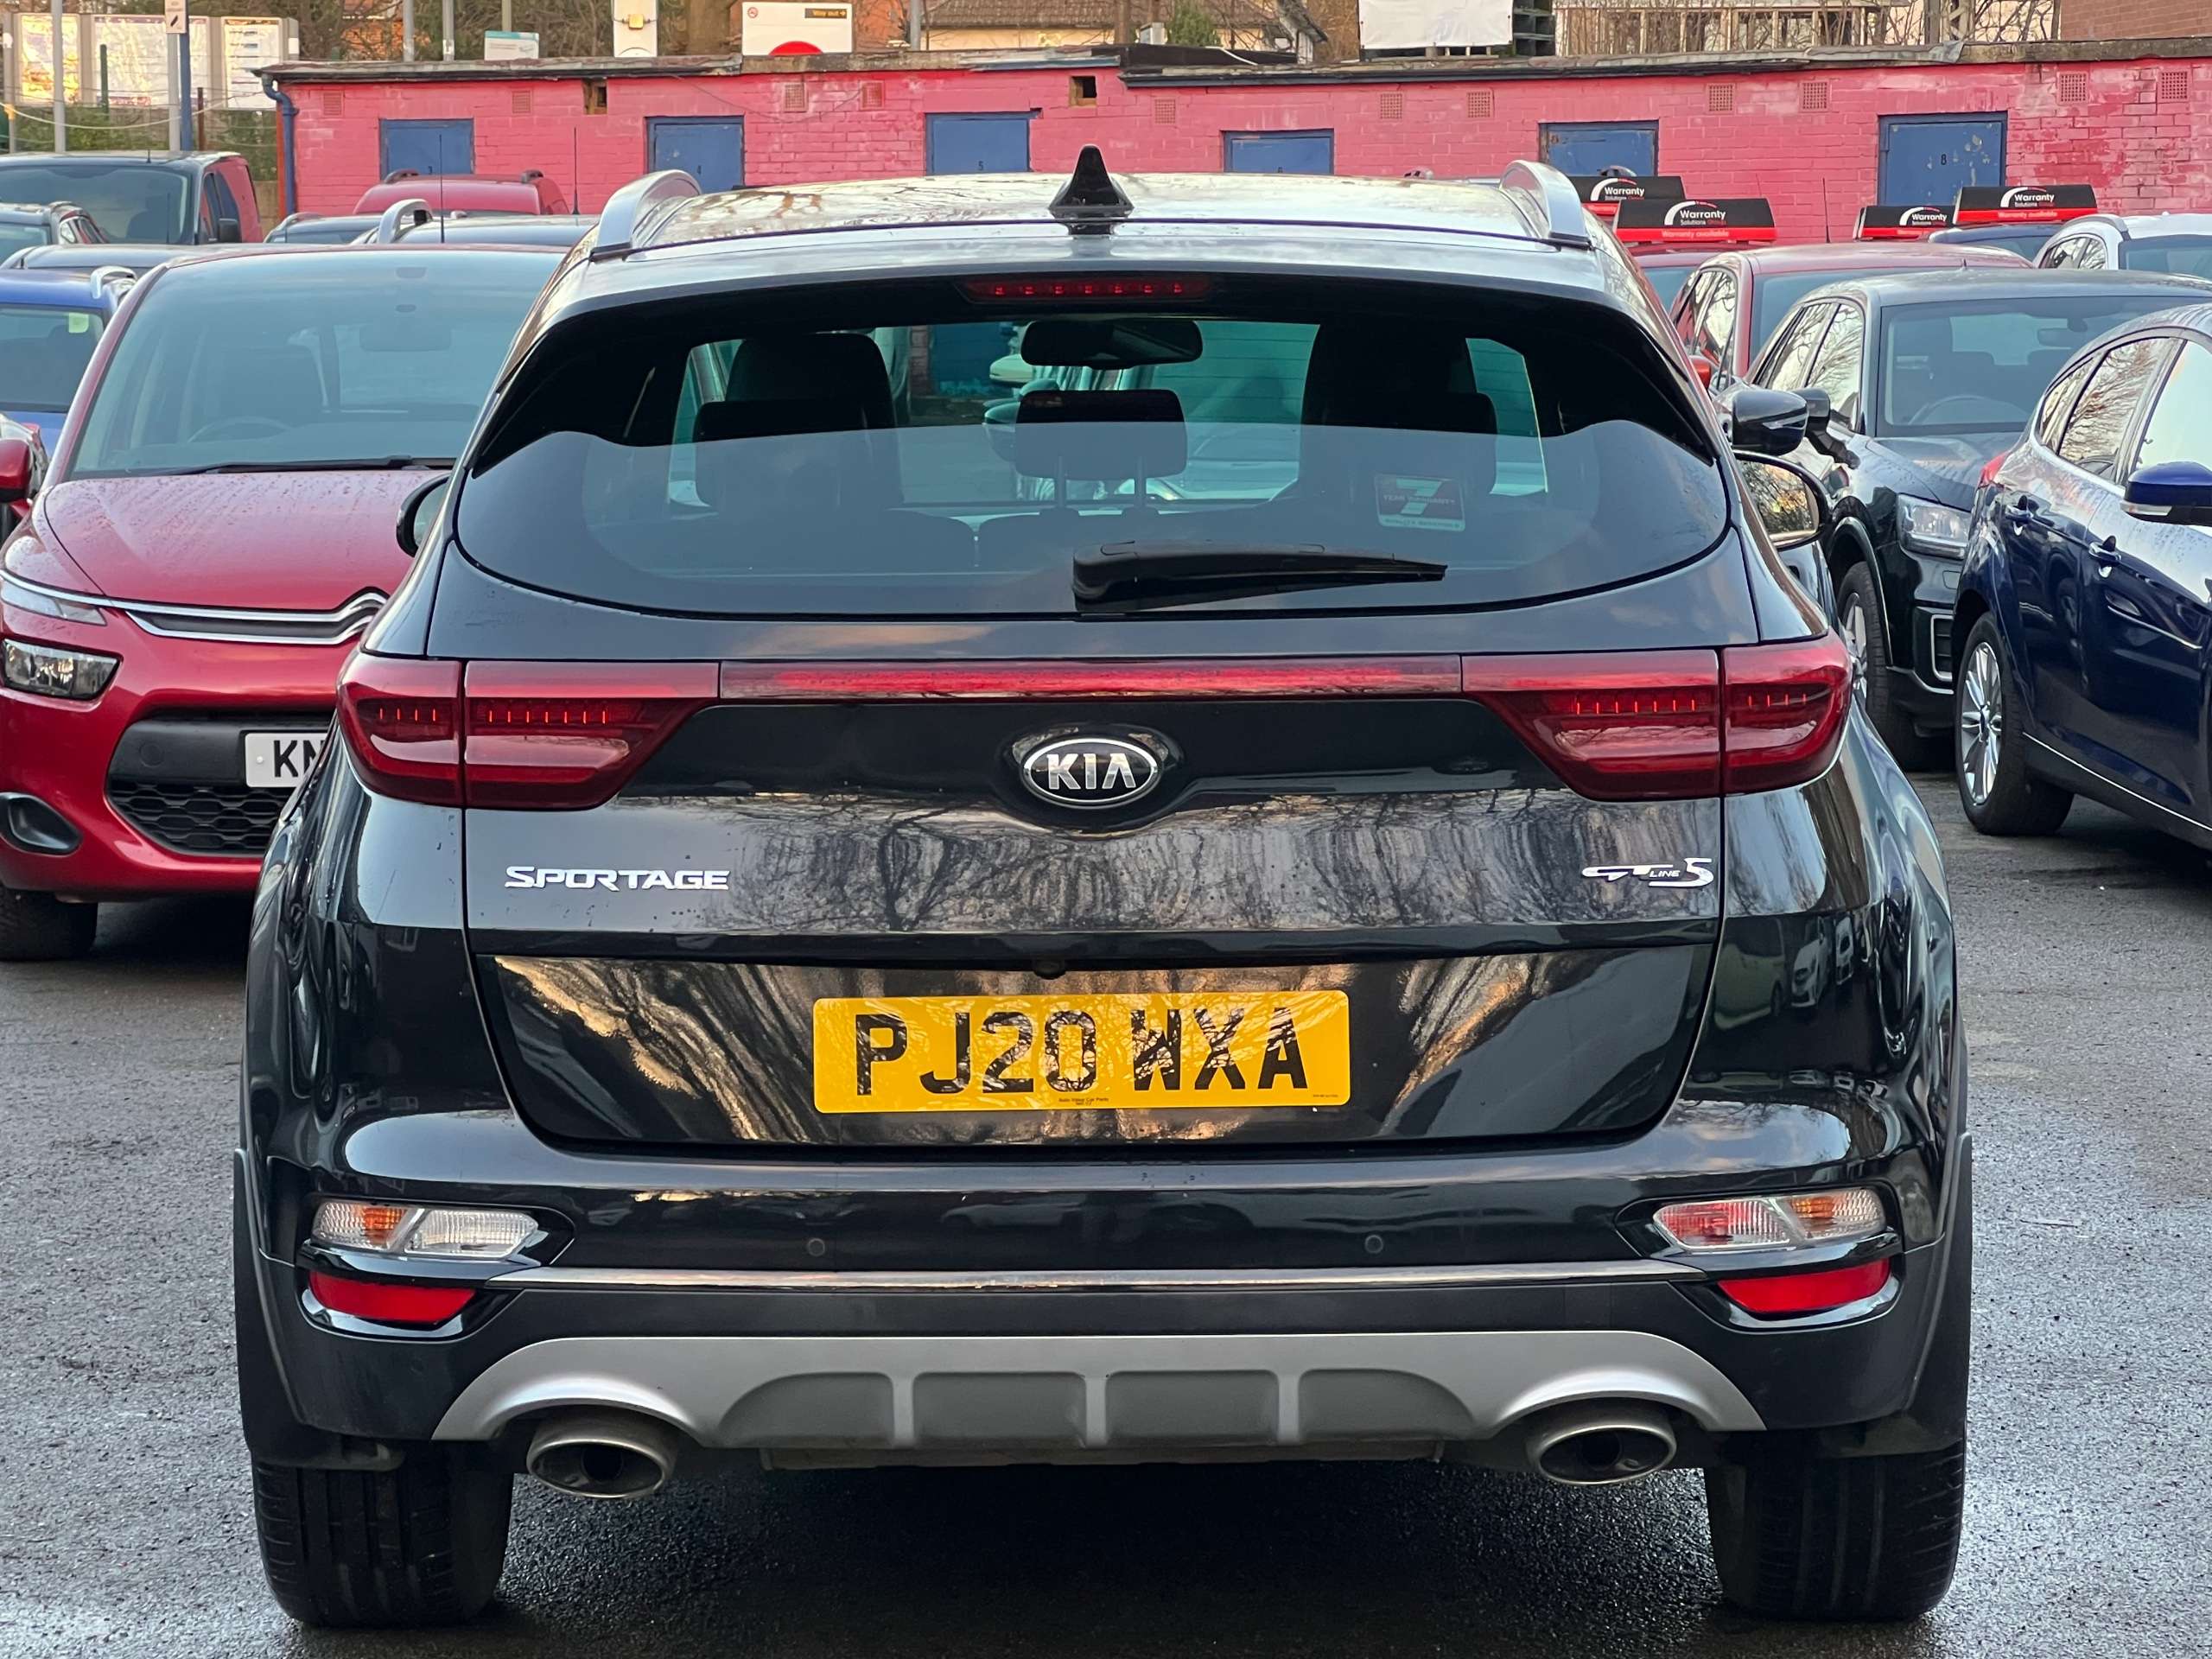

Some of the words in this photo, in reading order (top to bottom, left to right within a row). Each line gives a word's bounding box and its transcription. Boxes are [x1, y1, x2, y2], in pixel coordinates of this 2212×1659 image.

[1941, 154, 1948, 165] 8
[1605, 187, 1645, 197] Warranty
[2014, 194, 2055, 203] Warranty
[1680, 210, 1726, 220] Warranty
[1911, 213, 1947, 222] Warranty
[1661, 230, 1694, 239] Warranty
[1695, 229, 1730, 238] available
[1396, 478, 1442, 515] 7
[1047, 753, 1136, 790] KIA
[505, 866, 730, 892] SPORTAGE
[855, 1009, 1096, 1096] PJ20
[1130, 1007, 1308, 1090] WXA
